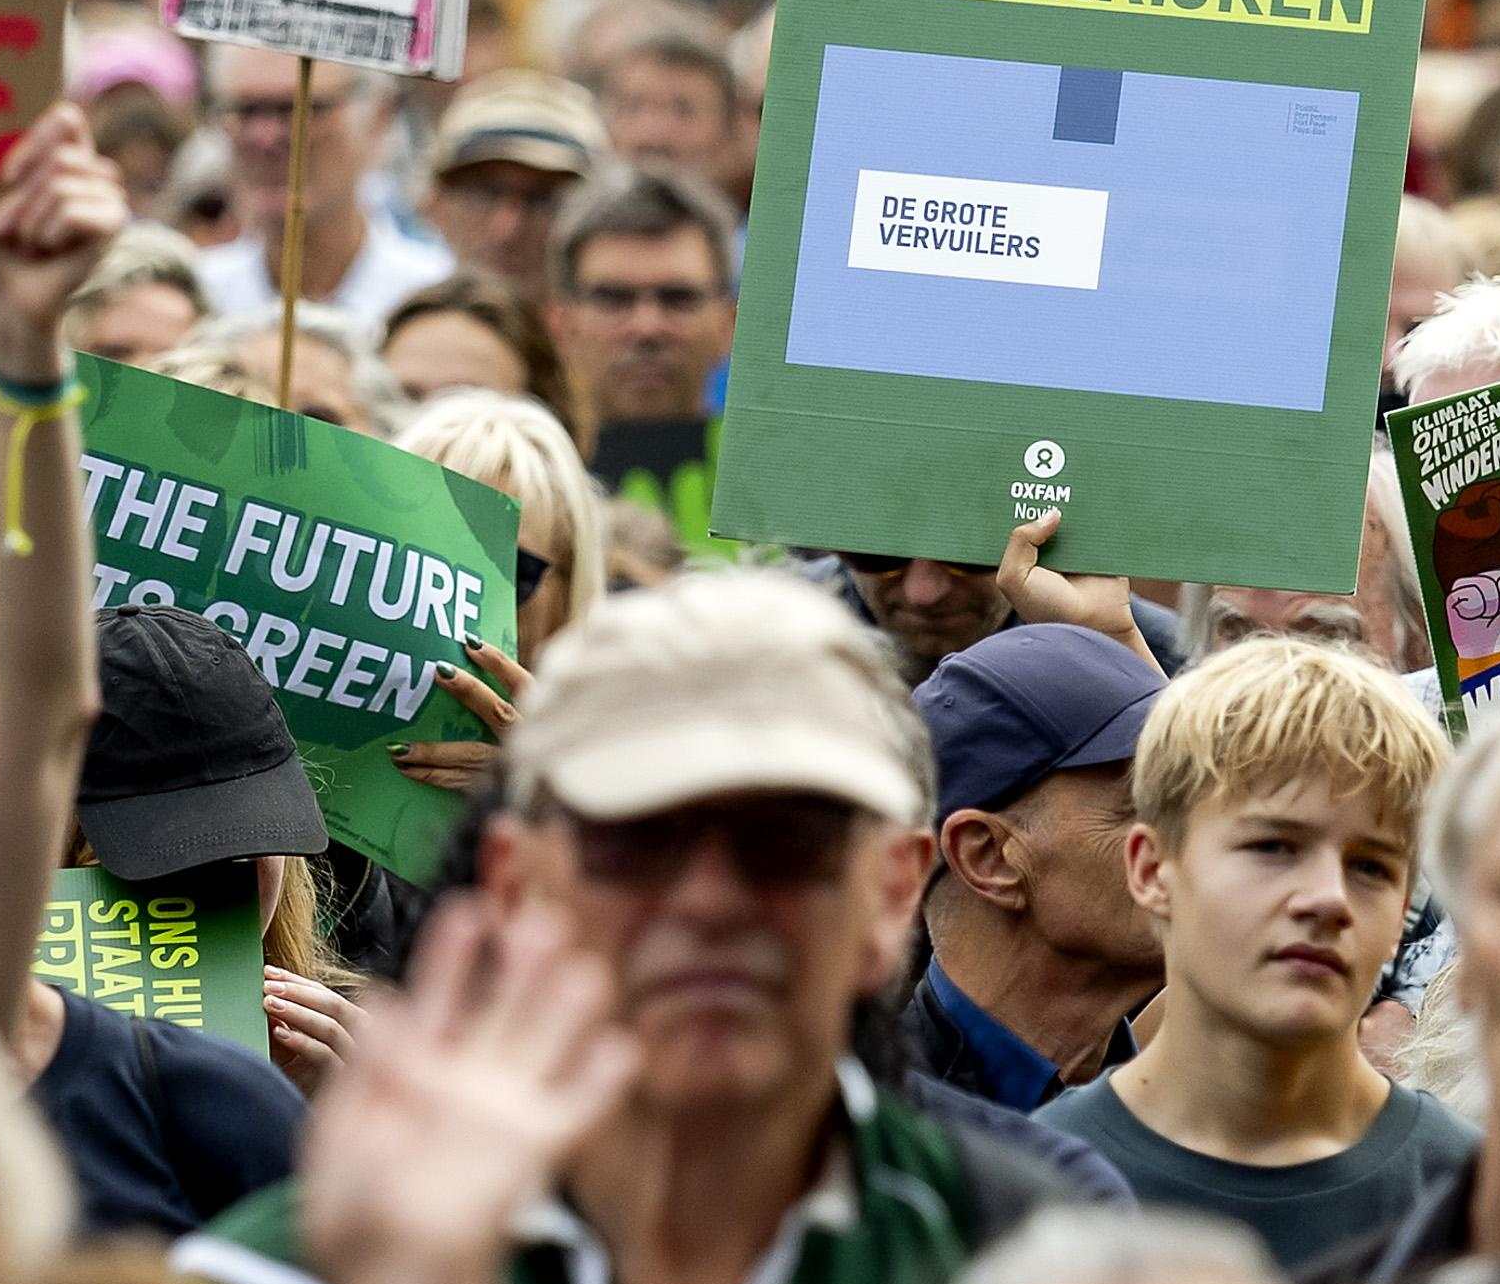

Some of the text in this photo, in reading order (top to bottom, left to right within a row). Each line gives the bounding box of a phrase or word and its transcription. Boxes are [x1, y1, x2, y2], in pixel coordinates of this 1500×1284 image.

[882, 196, 1008, 229] DE GROTE
[879, 223, 1041, 259] VERVUILERS
[1412, 390, 1492, 436] KLIMAAT
[1420, 422, 1498, 477] ZIJN IN DE
[1010, 482, 1071, 503] OXFAM
[80, 454, 481, 643] THE FUTURE
[147, 896, 199, 970] ONS
